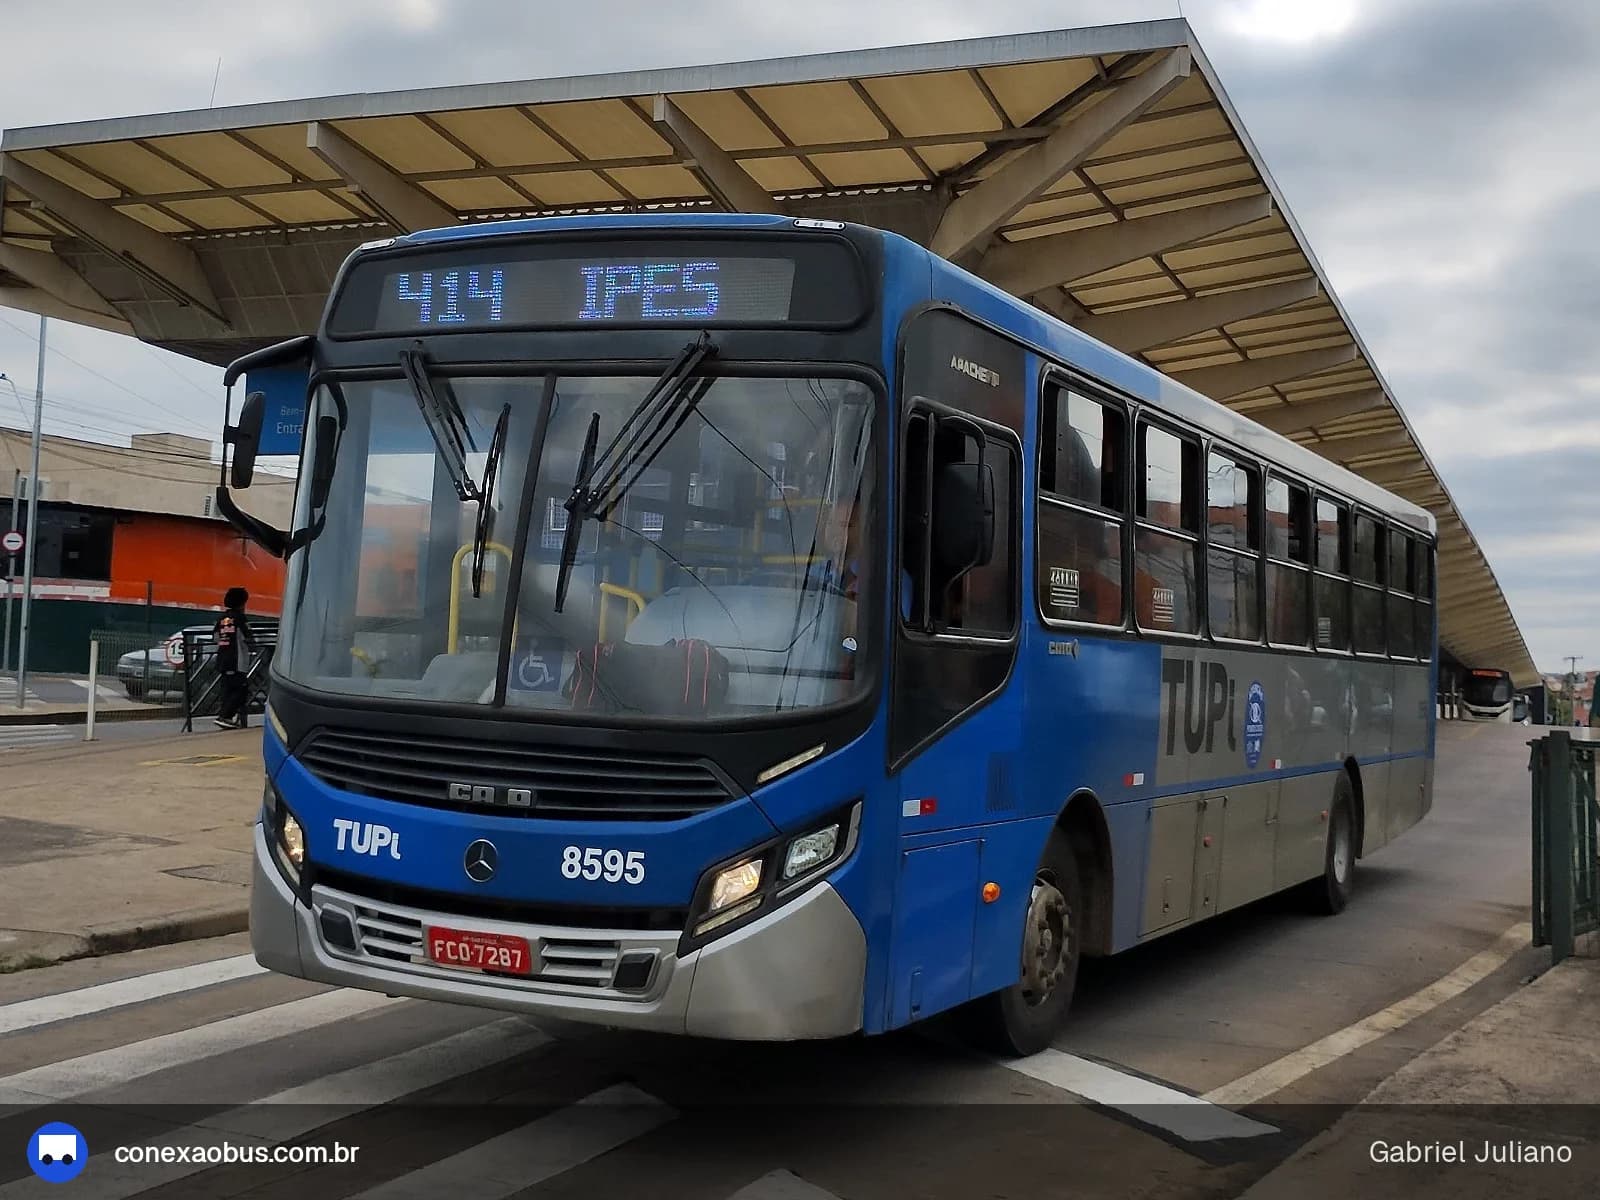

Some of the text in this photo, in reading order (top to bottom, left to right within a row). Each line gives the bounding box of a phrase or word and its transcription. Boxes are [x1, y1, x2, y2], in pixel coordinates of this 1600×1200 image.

[400, 262, 720, 322] 414 IPES
[1162, 658, 1237, 756] TUPi
[333, 818, 401, 860] TUPi
[561, 846, 645, 884] 8595
